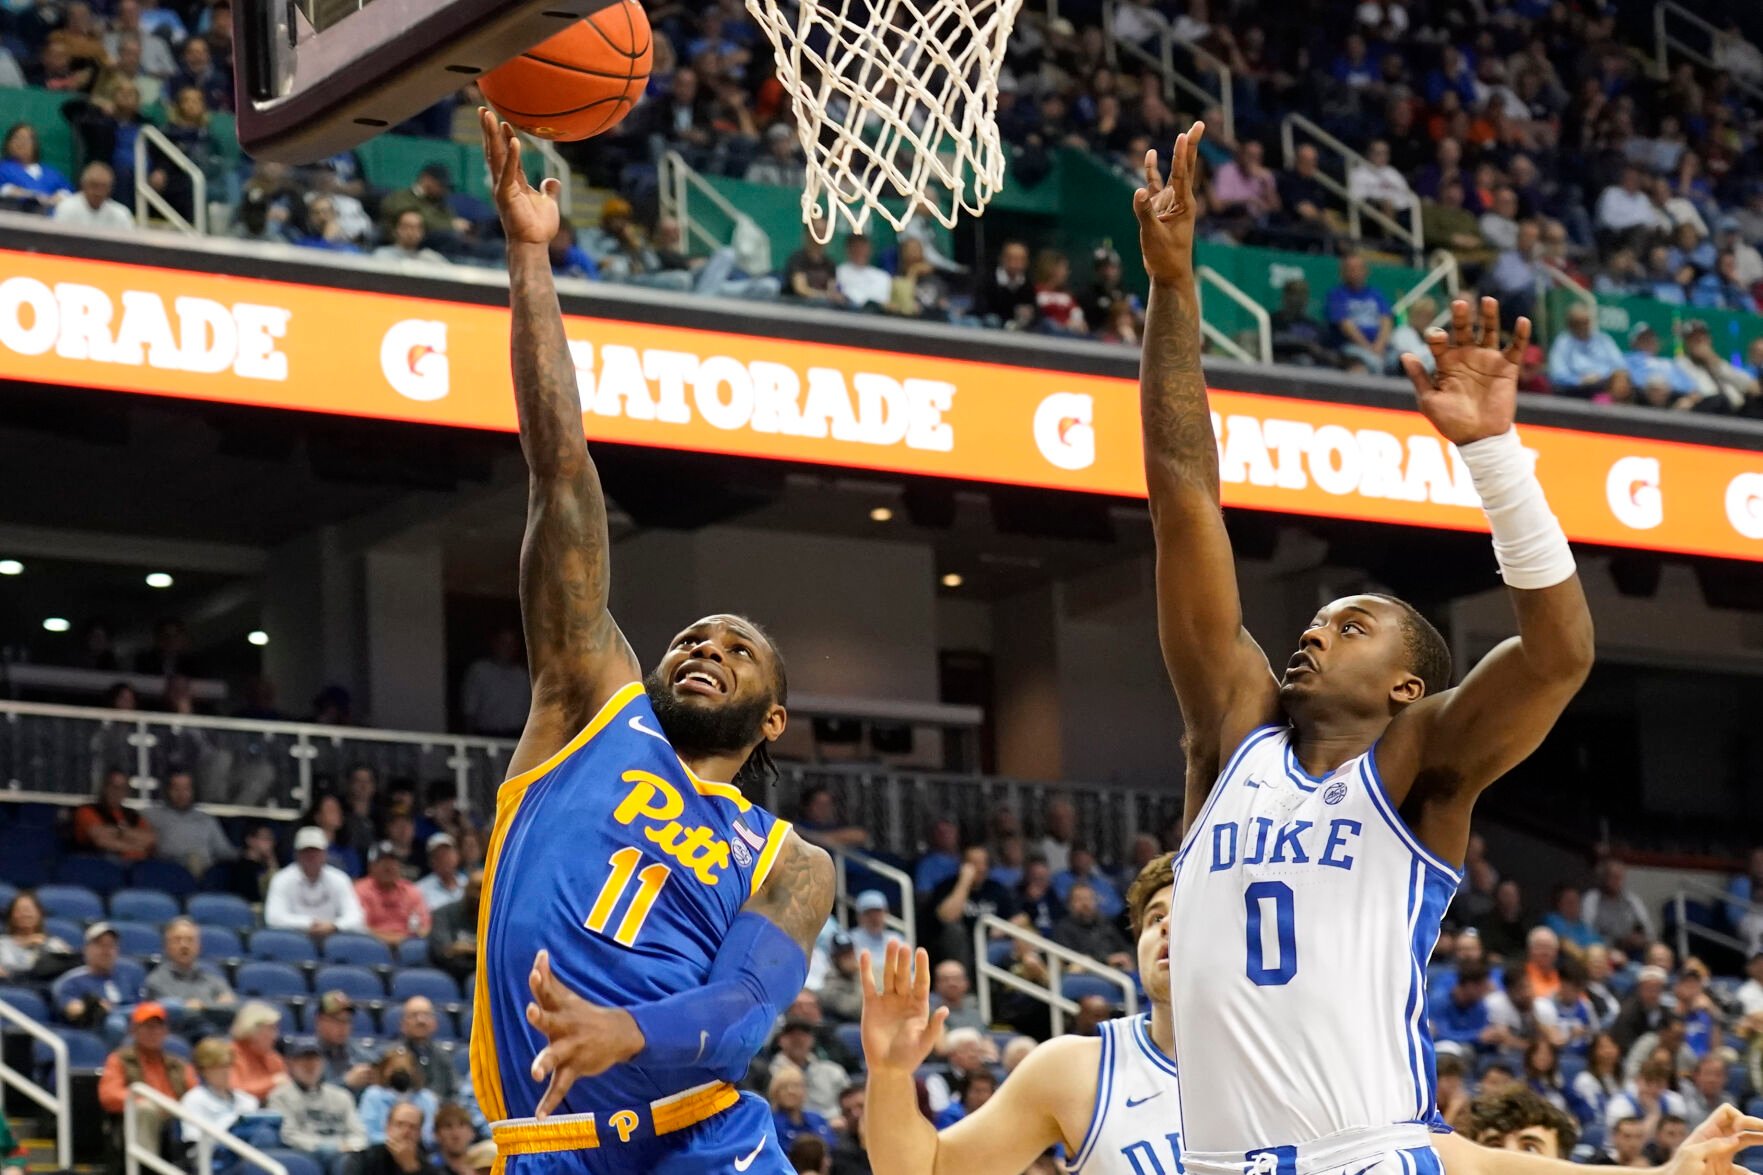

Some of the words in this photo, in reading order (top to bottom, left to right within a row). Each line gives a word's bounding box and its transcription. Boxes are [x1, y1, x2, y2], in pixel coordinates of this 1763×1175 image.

[380, 318, 450, 401] G
[1033, 392, 1095, 470] G
[1606, 456, 1663, 530] G
[613, 769, 730, 886] Pitt
[1210, 816, 1362, 872] DUKE
[583, 846, 672, 948] 11
